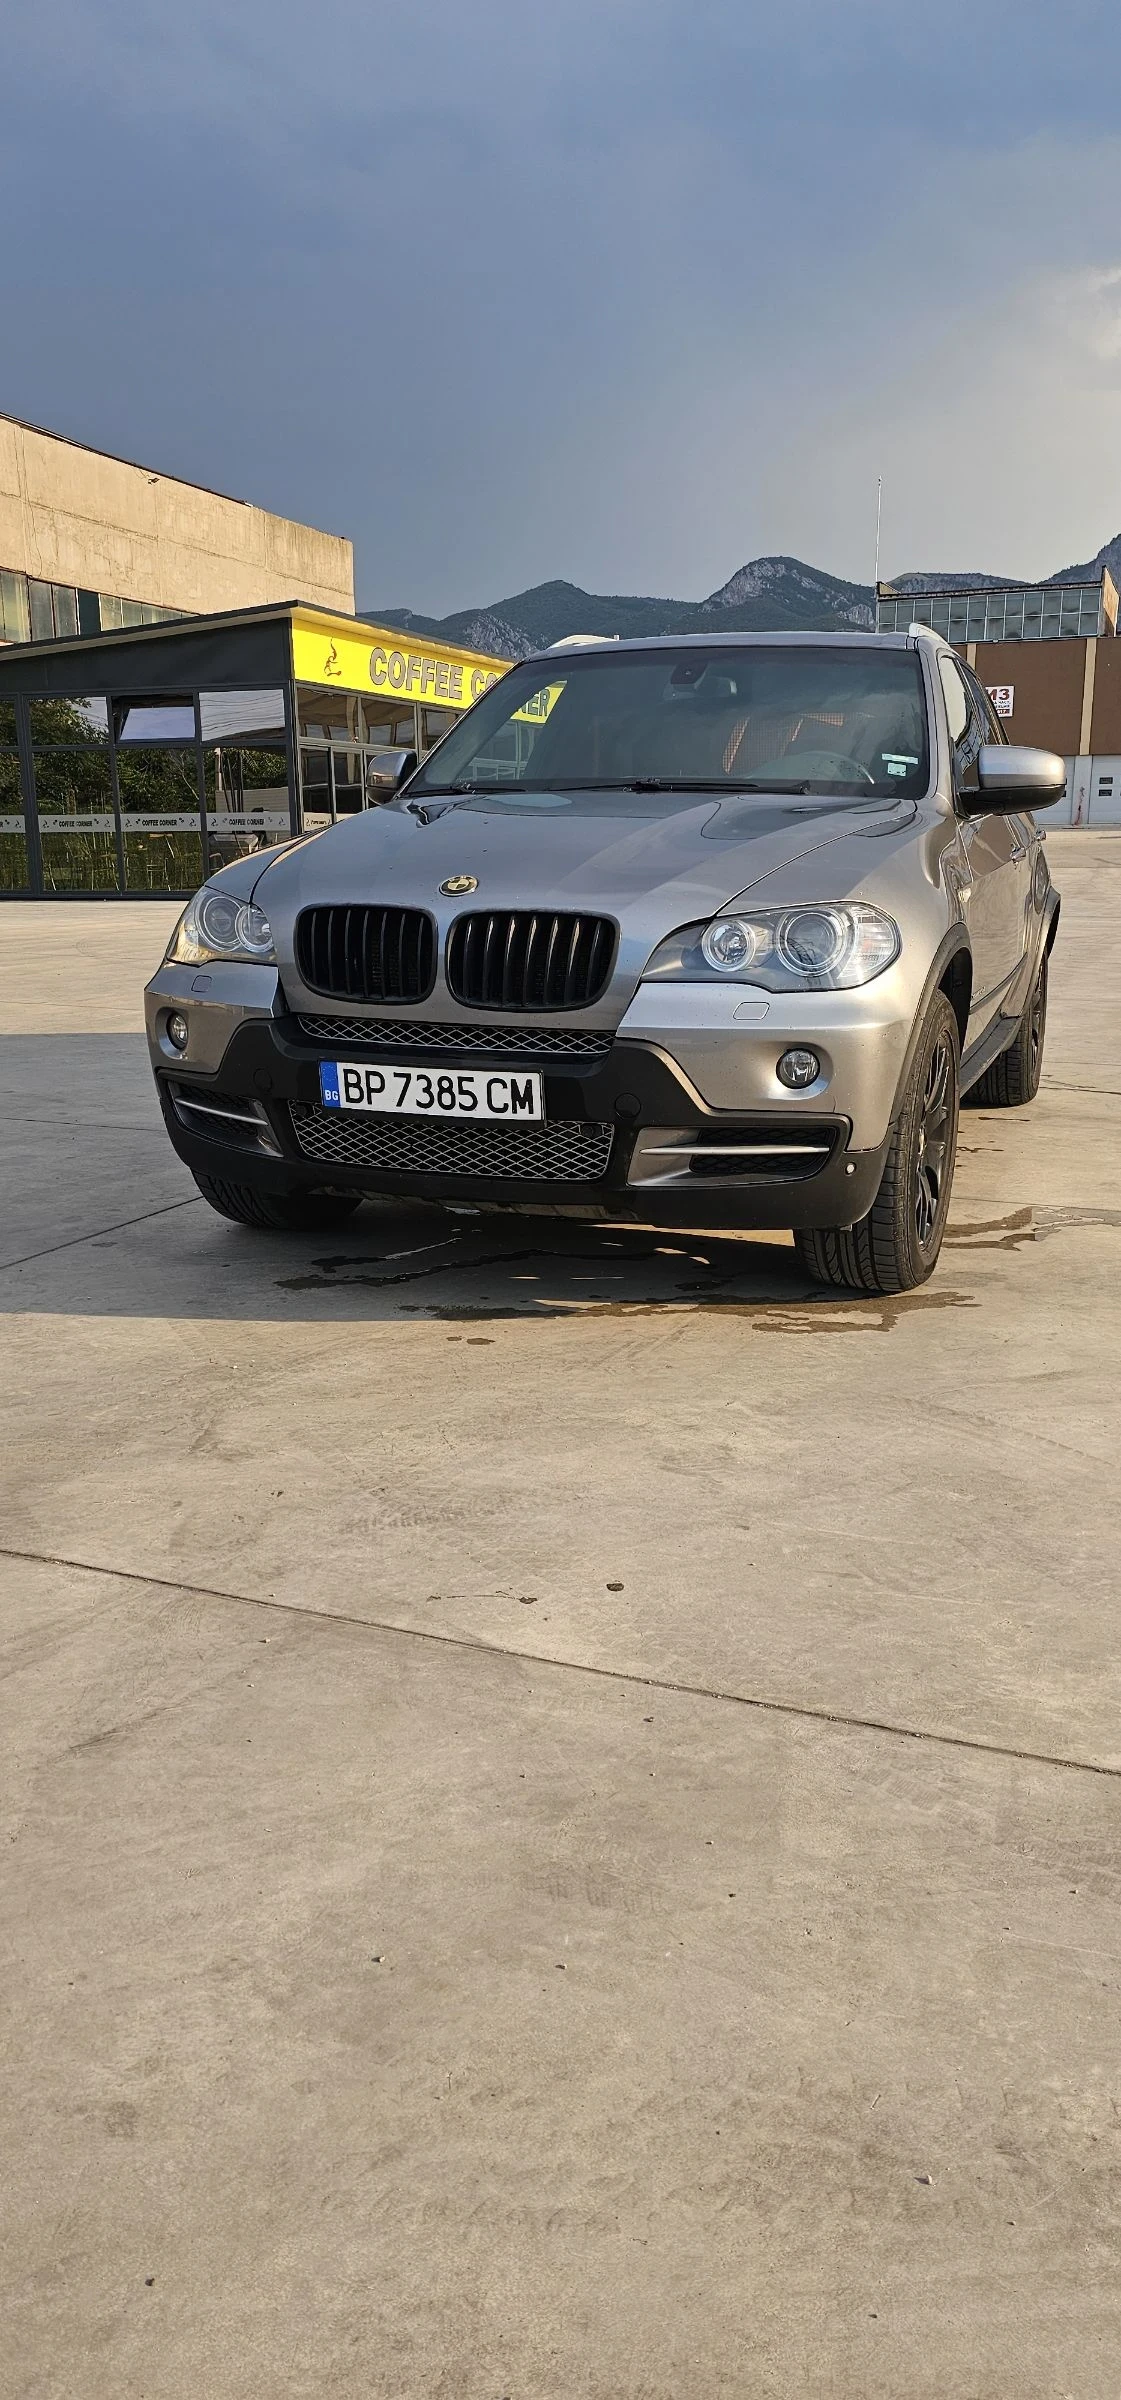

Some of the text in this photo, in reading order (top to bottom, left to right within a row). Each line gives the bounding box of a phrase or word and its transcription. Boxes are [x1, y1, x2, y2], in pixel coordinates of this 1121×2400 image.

[369, 647, 463, 700] COFFEE
[141, 819, 159, 827] COFFEE
[228, 818, 265, 826] COFFEE CORNER
[324, 1089, 339, 1101] BG
[343, 1068, 534, 1115] BP 7385 CM
